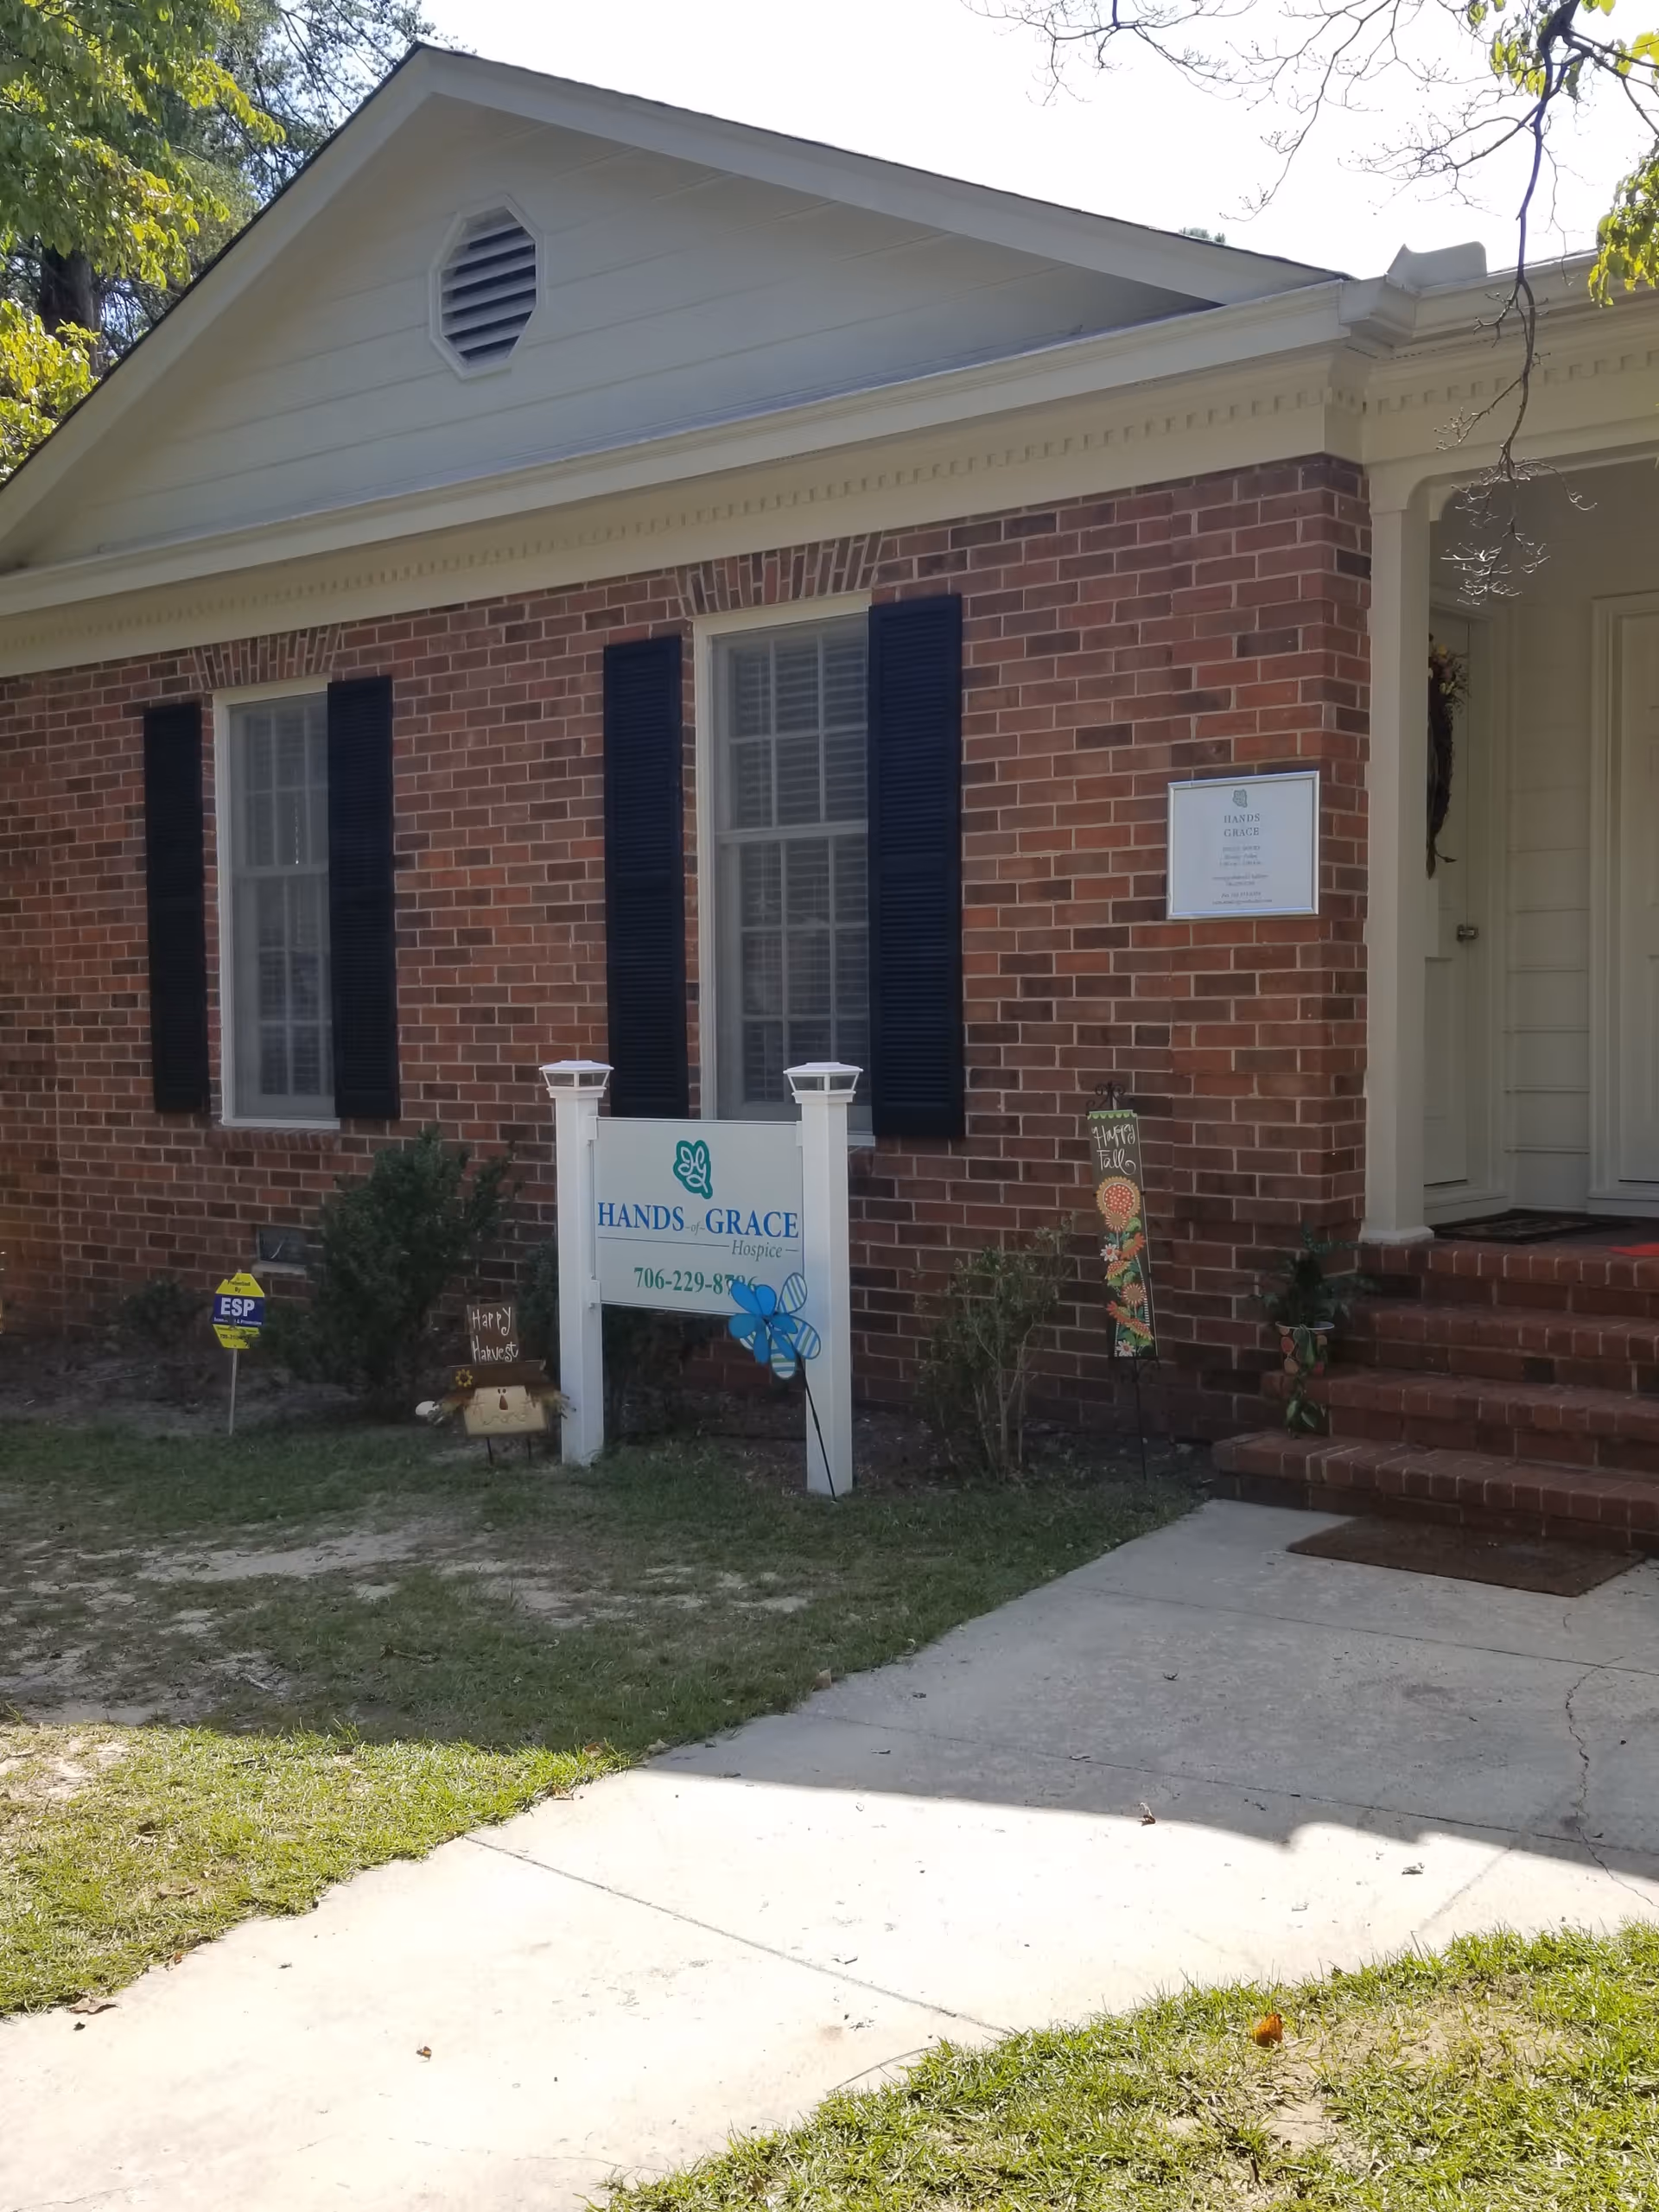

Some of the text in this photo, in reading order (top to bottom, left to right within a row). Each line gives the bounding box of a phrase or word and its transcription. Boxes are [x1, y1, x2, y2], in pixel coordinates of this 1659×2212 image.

[1224, 813, 1261, 823] HANDS
[1224, 827, 1260, 837] GRACE
[1091, 1122, 1136, 1149] Happy
[1096, 1147, 1136, 1175] Fall
[598, 1202, 684, 1231] HANDS
[705, 1208, 799, 1238] GRACE
[732, 1239, 783, 1262] Hospice
[220, 1297, 255, 1317] ESP
[472, 1306, 512, 1336] Happy
